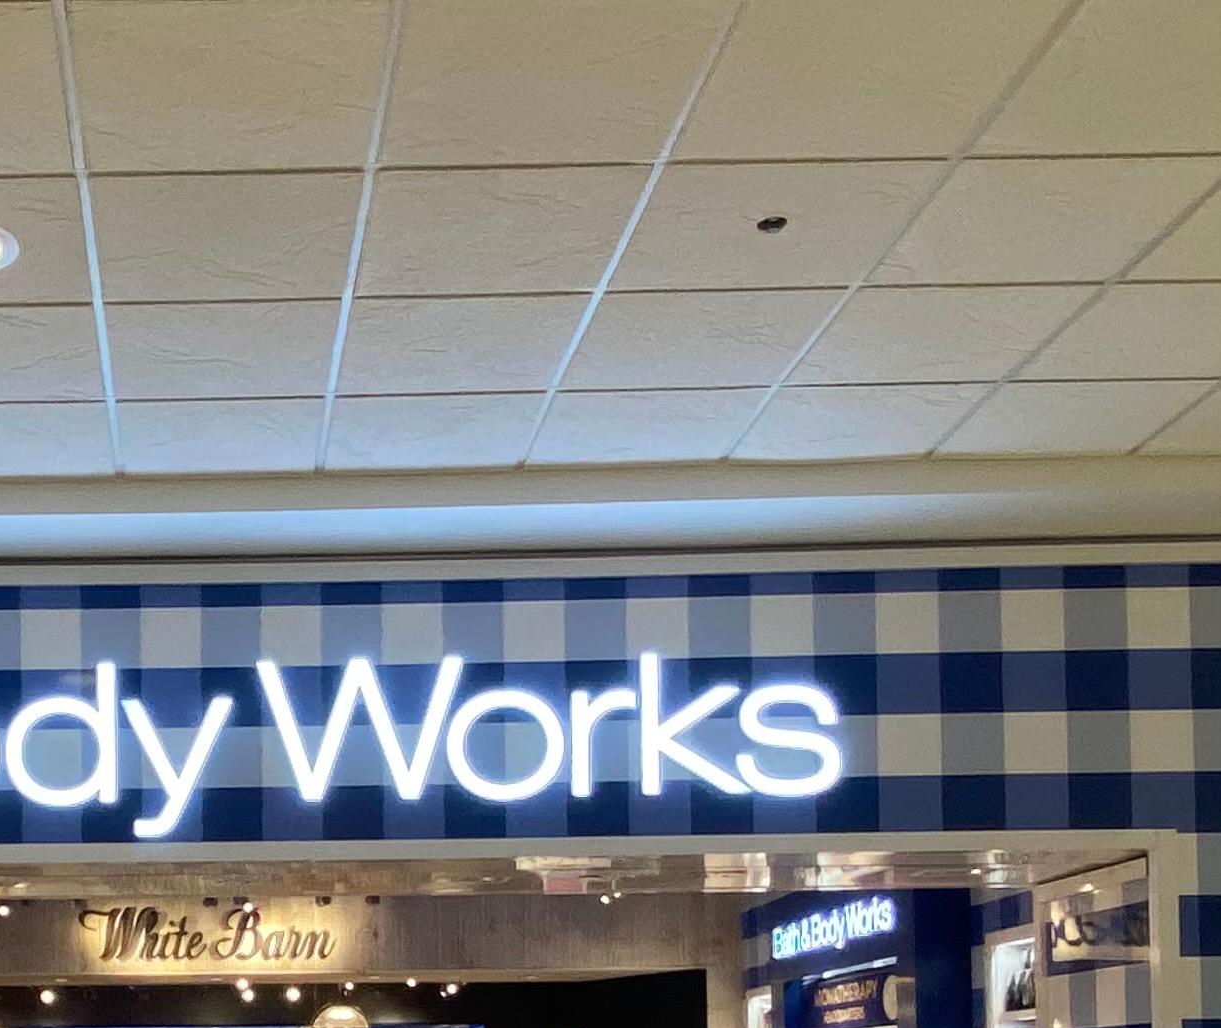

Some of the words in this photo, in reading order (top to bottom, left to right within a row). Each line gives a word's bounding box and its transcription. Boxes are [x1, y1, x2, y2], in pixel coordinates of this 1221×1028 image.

[255, 652, 843, 803] Works
[78, 906, 208, 962] White
[207, 903, 338, 962] Barn
[772, 922, 800, 960] Bath
[800, 918, 812, 951] &
[810, 909, 846, 950] Body
[844, 895, 893, 939] Works
